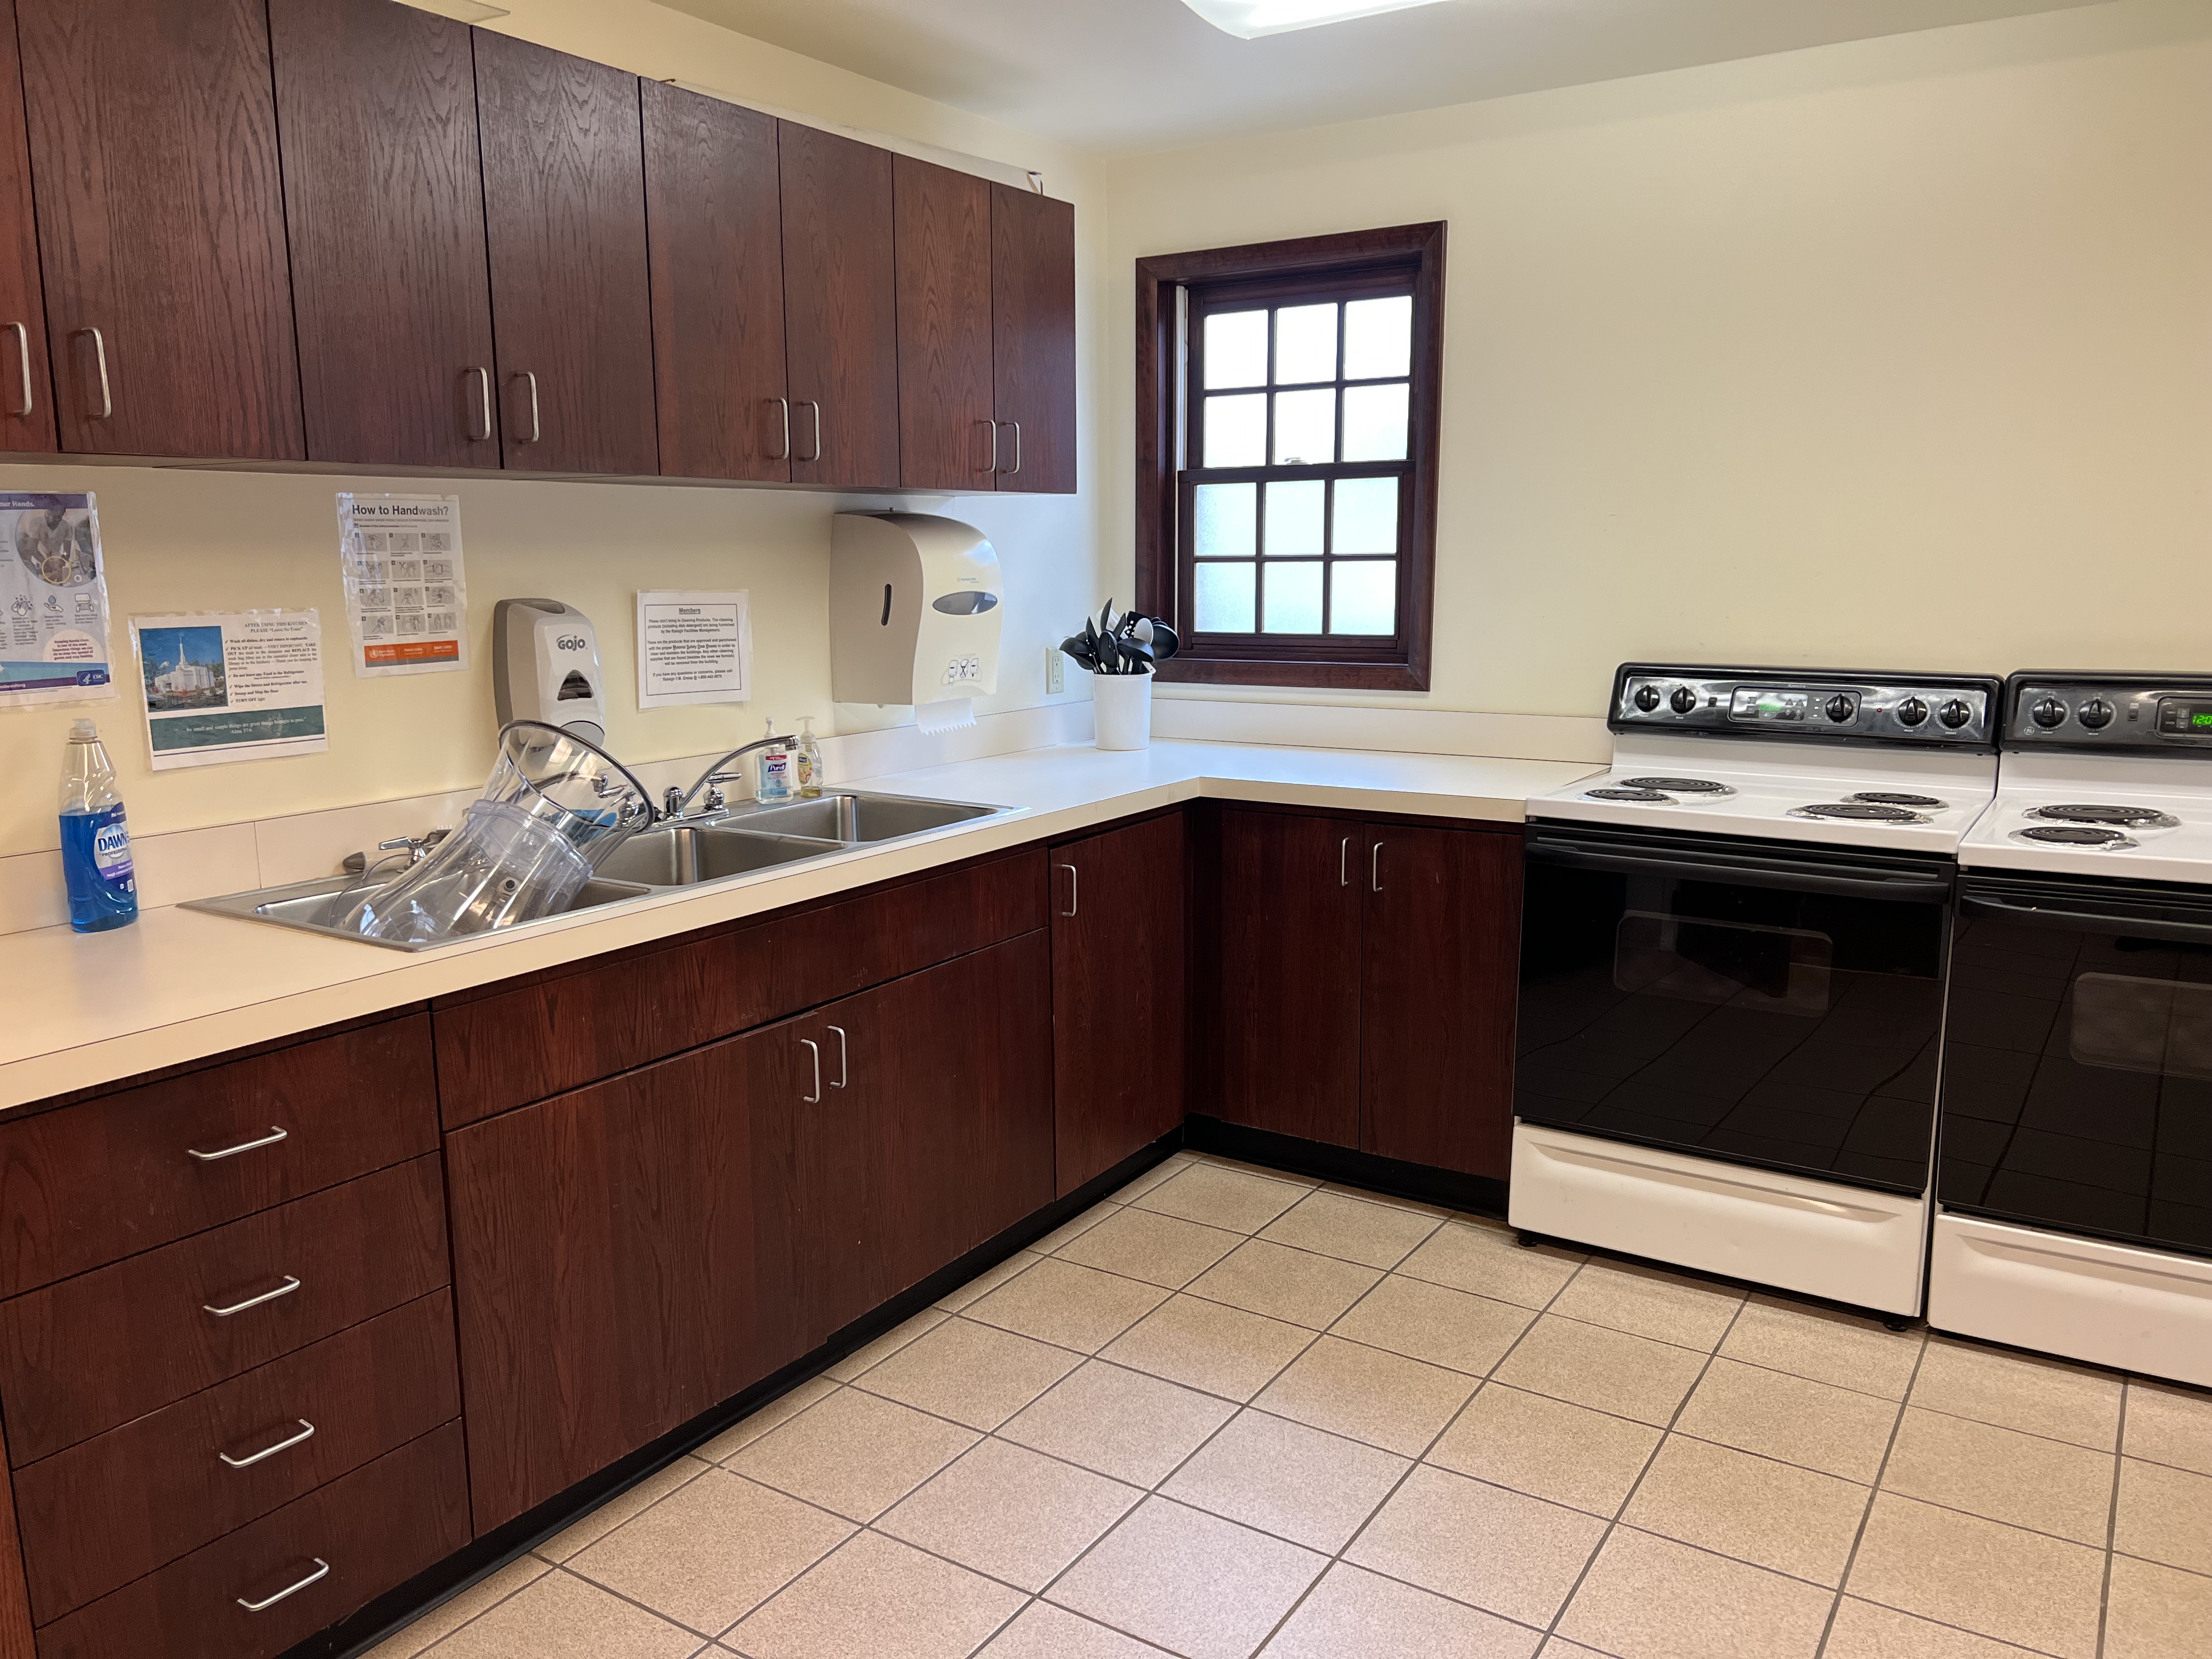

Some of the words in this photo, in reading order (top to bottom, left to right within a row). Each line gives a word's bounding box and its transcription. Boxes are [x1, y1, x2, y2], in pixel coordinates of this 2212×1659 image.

[352, 504, 375, 515] How
[379, 505, 389, 515] to
[392, 504, 449, 516] Handwash?
[557, 635, 586, 651] GOJO
[98, 832, 128, 852] DAWN
